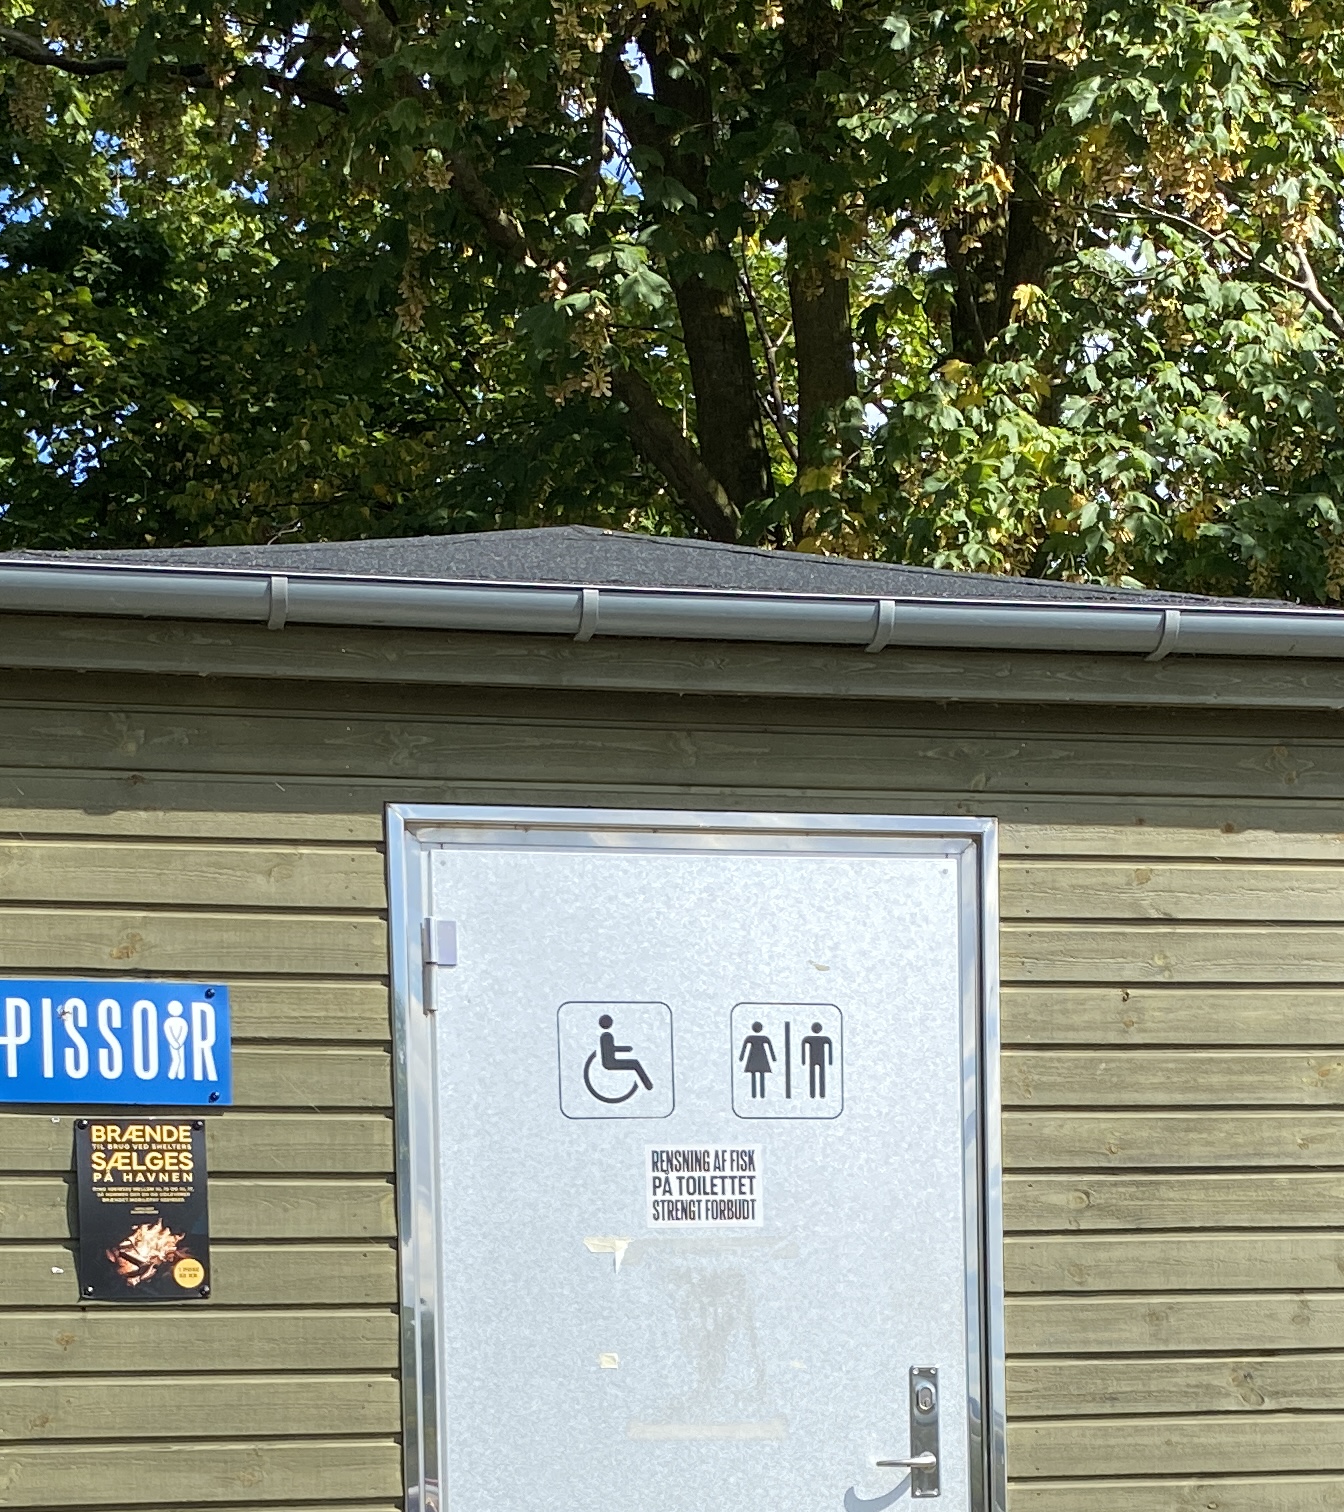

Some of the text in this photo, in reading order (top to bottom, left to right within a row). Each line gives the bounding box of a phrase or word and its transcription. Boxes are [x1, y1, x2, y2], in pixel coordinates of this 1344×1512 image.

[91, 1125, 192, 1142] BRÆNDE
[91, 1151, 194, 1170] SÆLGES
[651, 1149, 756, 1172] RENSNING AF FISK
[93, 1169, 193, 1182] PÅ HAVNEN
[652, 1170, 756, 1196] PÅ TOILETTET
[652, 1199, 757, 1221] STRENGT FORBUDT
